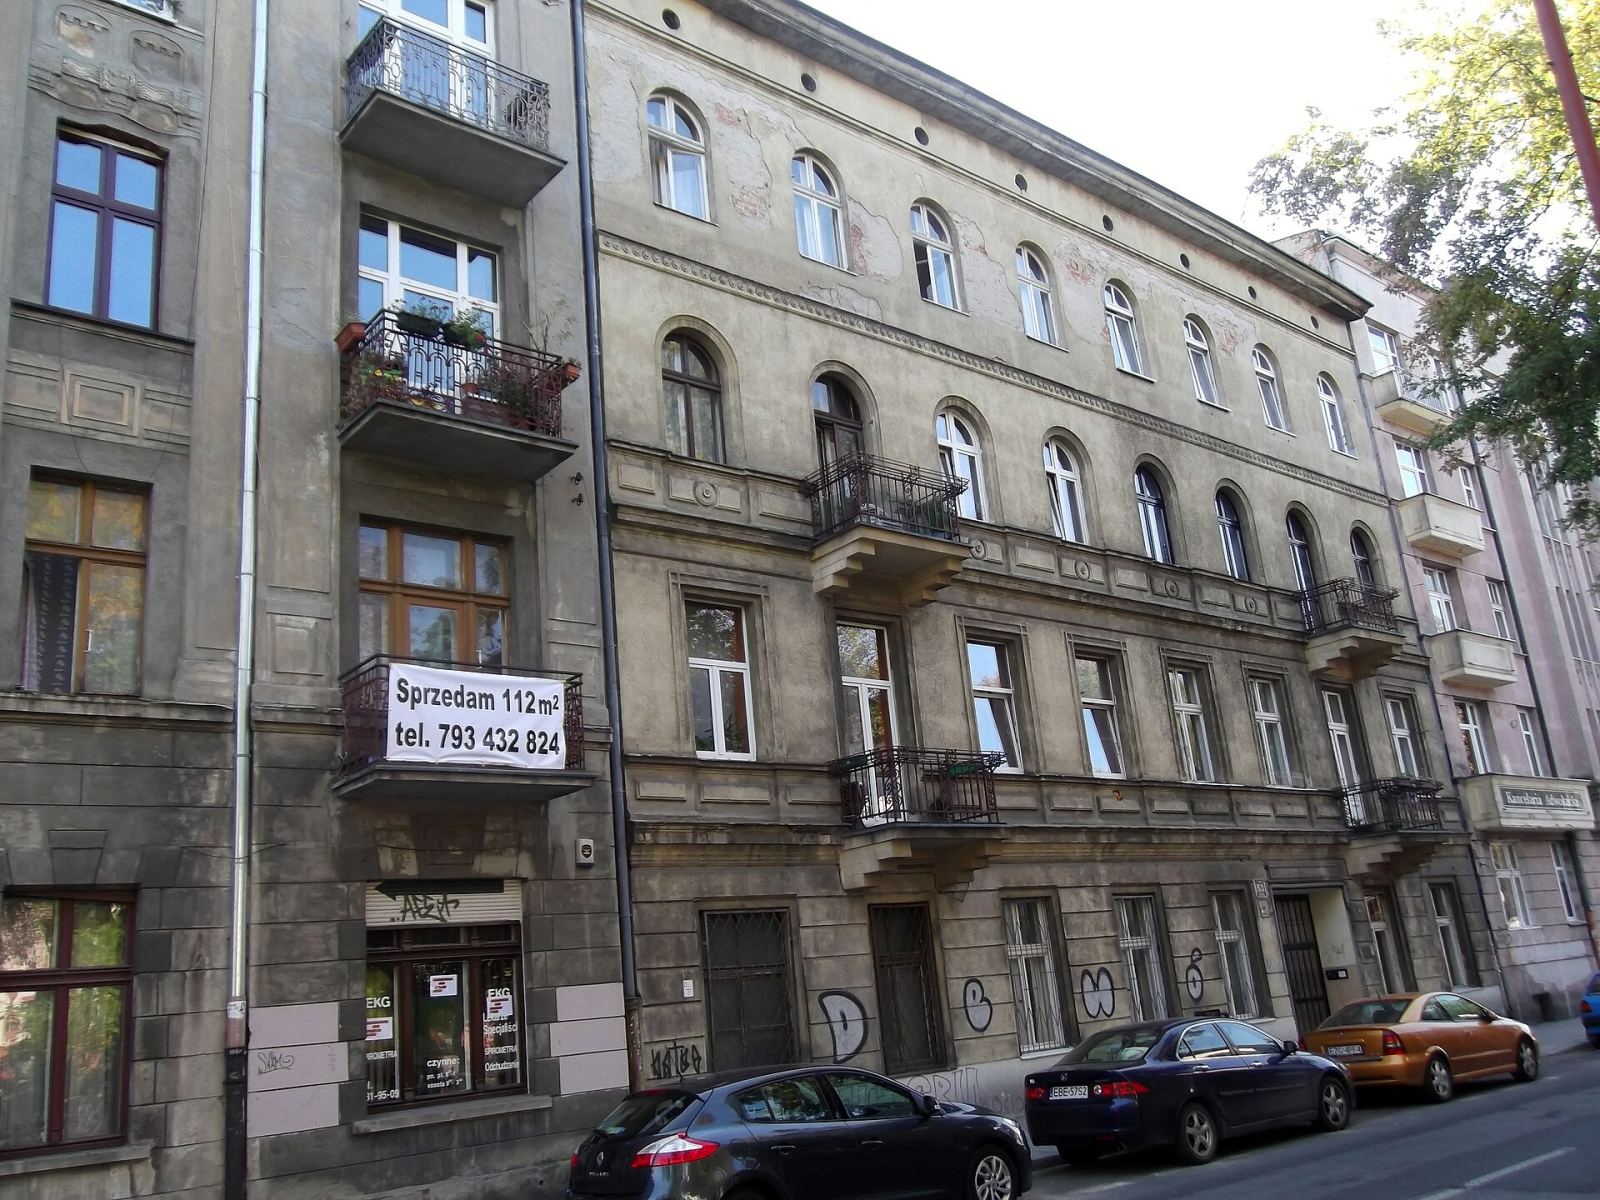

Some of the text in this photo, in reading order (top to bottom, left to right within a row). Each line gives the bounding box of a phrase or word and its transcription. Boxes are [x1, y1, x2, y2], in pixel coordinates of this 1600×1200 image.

[396, 677, 495, 710] Sprzedam
[395, 721, 560, 755] tel. 793 432 824
[366, 996, 390, 1009] EKG
[487, 987, 511, 998] EKG
